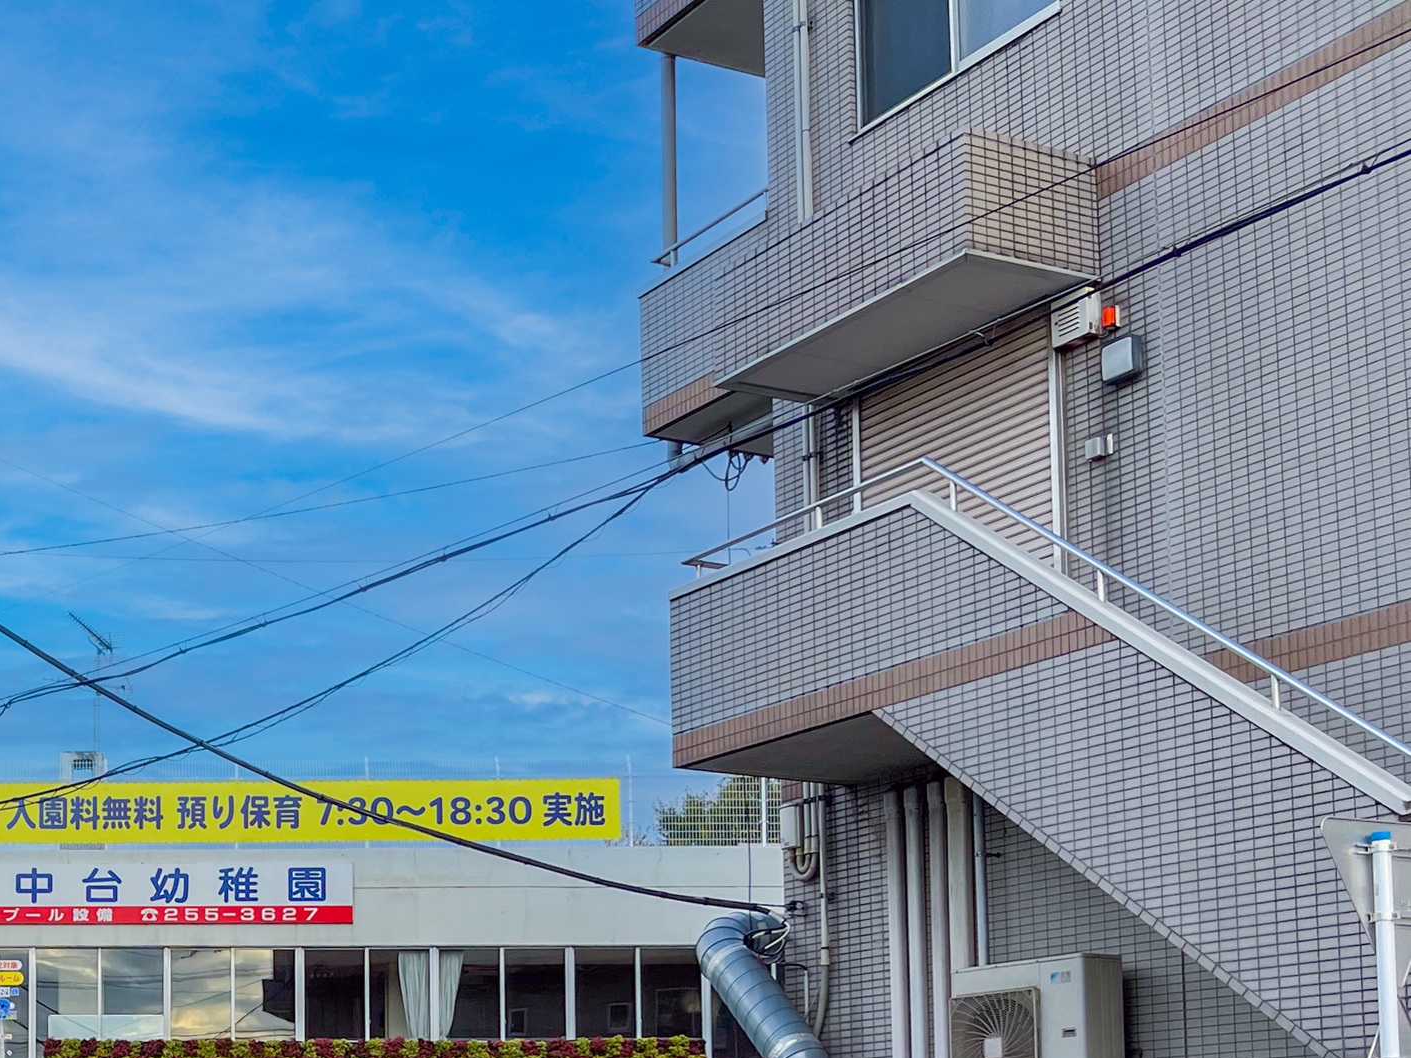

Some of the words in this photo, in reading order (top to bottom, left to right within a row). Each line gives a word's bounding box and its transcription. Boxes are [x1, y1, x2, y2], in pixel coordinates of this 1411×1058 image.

[6, 794, 164, 831] 入園料無料
[175, 793, 302, 830] 預り保育
[542, 791, 606, 827] 実施
